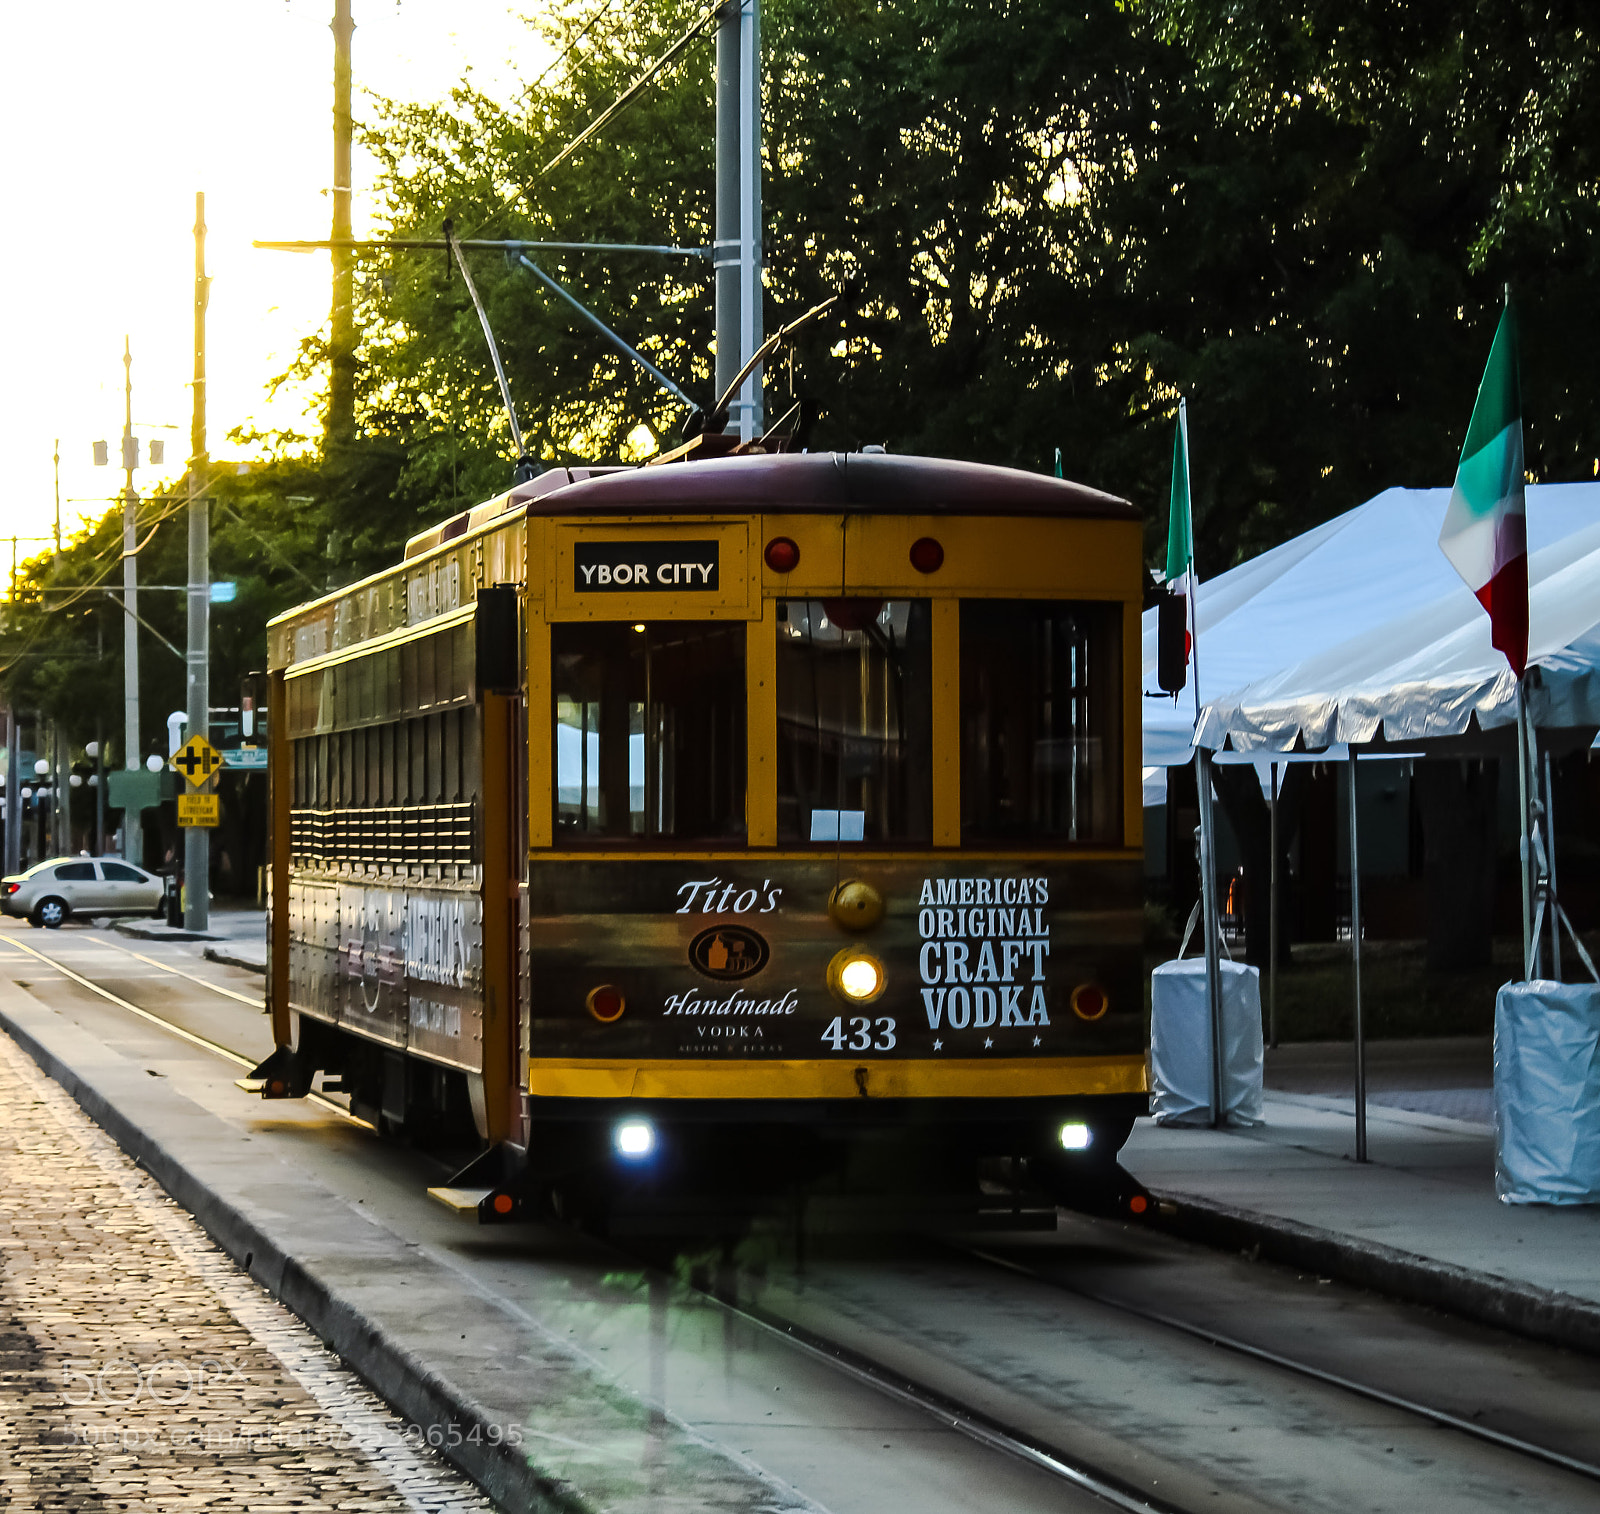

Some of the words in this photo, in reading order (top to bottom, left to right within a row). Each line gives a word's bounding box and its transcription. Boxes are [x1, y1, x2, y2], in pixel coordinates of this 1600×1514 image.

[580, 564, 650, 585] YBOR
[656, 562, 714, 584] CITY
[675, 876, 783, 914] Tito's
[918, 878, 1049, 906] AMERICA'S
[918, 907, 1050, 938] ORIGINAL
[919, 939, 1050, 985] CRAFT
[662, 987, 798, 1017] Handmade
[920, 985, 1051, 1030] VODKA
[697, 1025, 764, 1038] VODKA
[820, 1016, 897, 1051] 433
